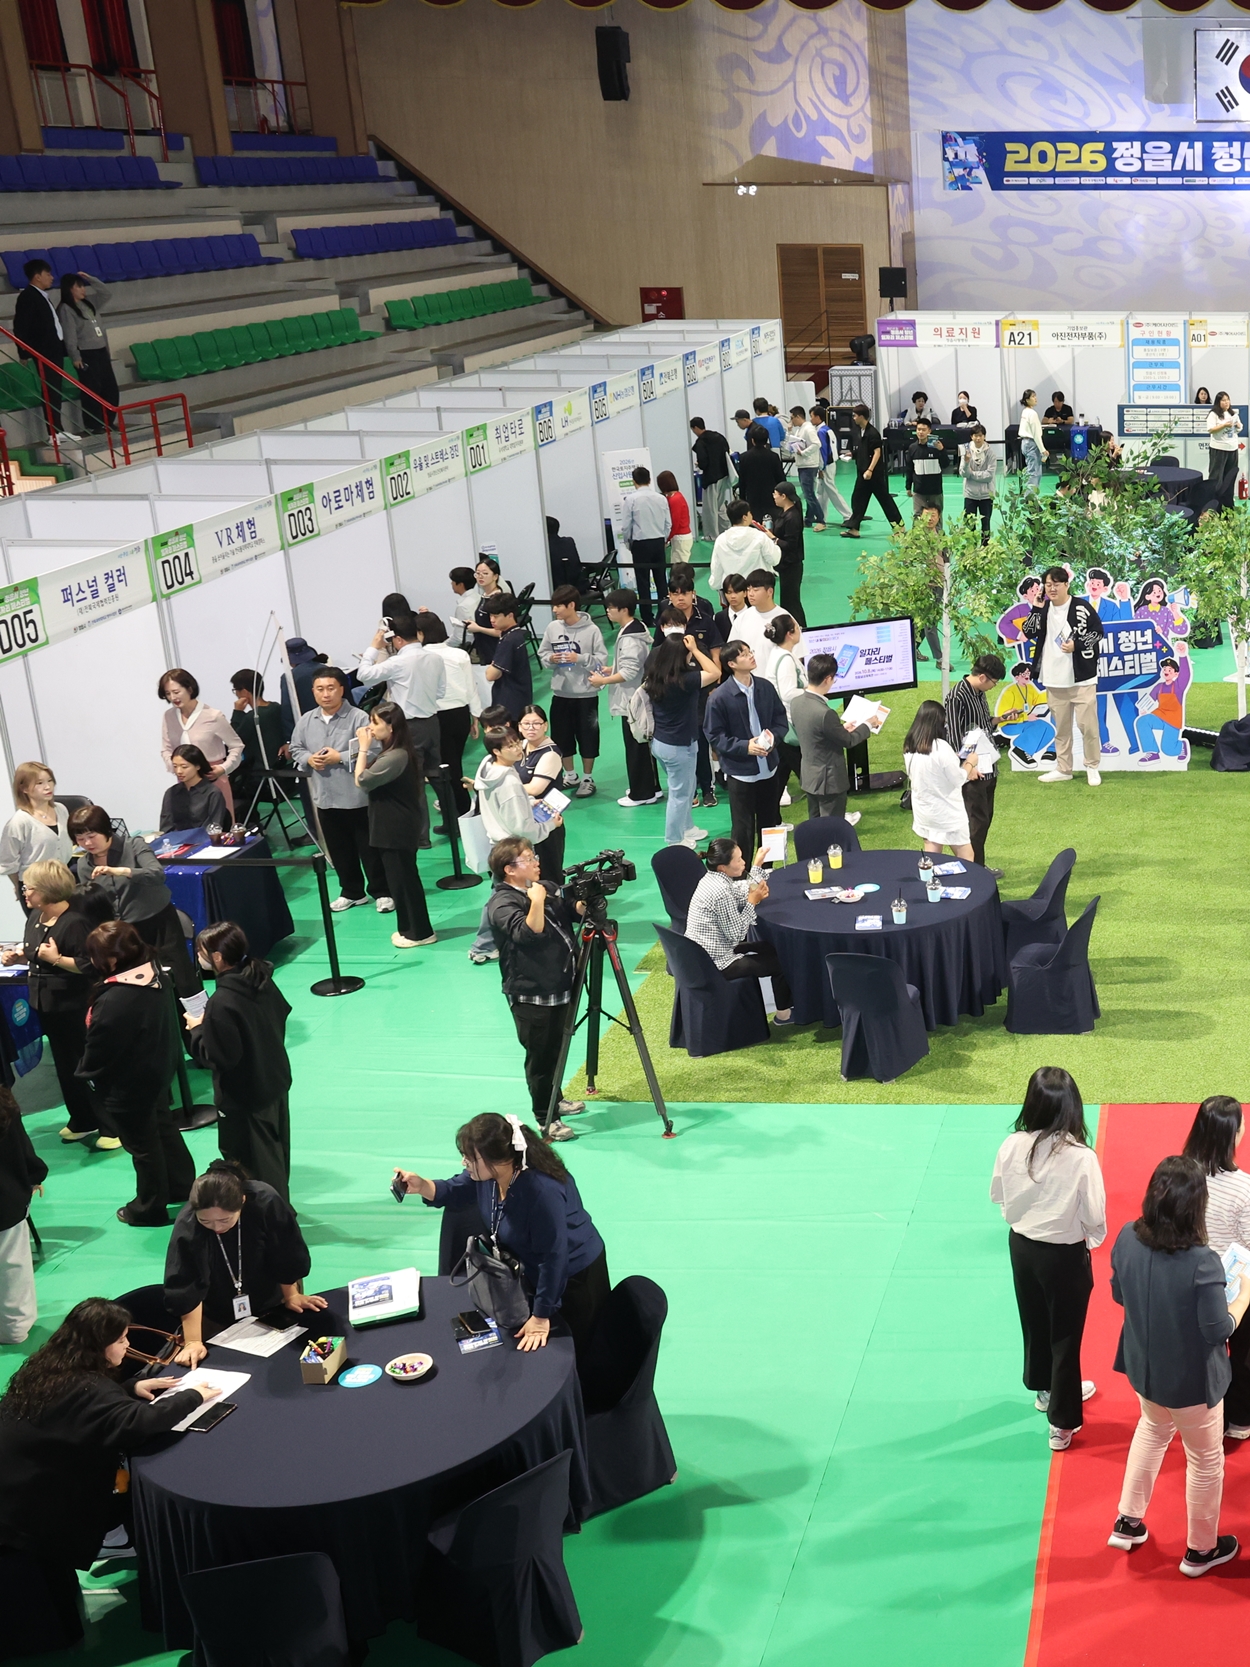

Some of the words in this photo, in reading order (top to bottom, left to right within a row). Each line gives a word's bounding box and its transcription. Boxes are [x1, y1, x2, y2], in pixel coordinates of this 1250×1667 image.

[1004, 141, 1107, 172] 2026
[1112, 141, 1203, 172] 정읍시
[933, 327, 981, 338] 의료지원
[1008, 331, 1032, 346] A21
[1051, 332, 1107, 341] 아진전자부품(주)
[1191, 333, 1206, 343] A01
[643, 380, 655, 400] B04
[594, 398, 607, 420] B05
[538, 419, 553, 443] B06
[469, 444, 487, 469] D01
[390, 472, 411, 501] D02
[288, 507, 315, 540] D03
[321, 477, 375, 515] 아로마체험
[161, 552, 194, 590] D04
[0, 609, 39, 655] D05
[61, 576, 100, 607] 퍼스널
[104, 566, 128, 593] 컬러
[859, 647, 881, 657] 일자리
[1118, 629, 1153, 653] 청년
[864, 655, 893, 666] 페스티벌
